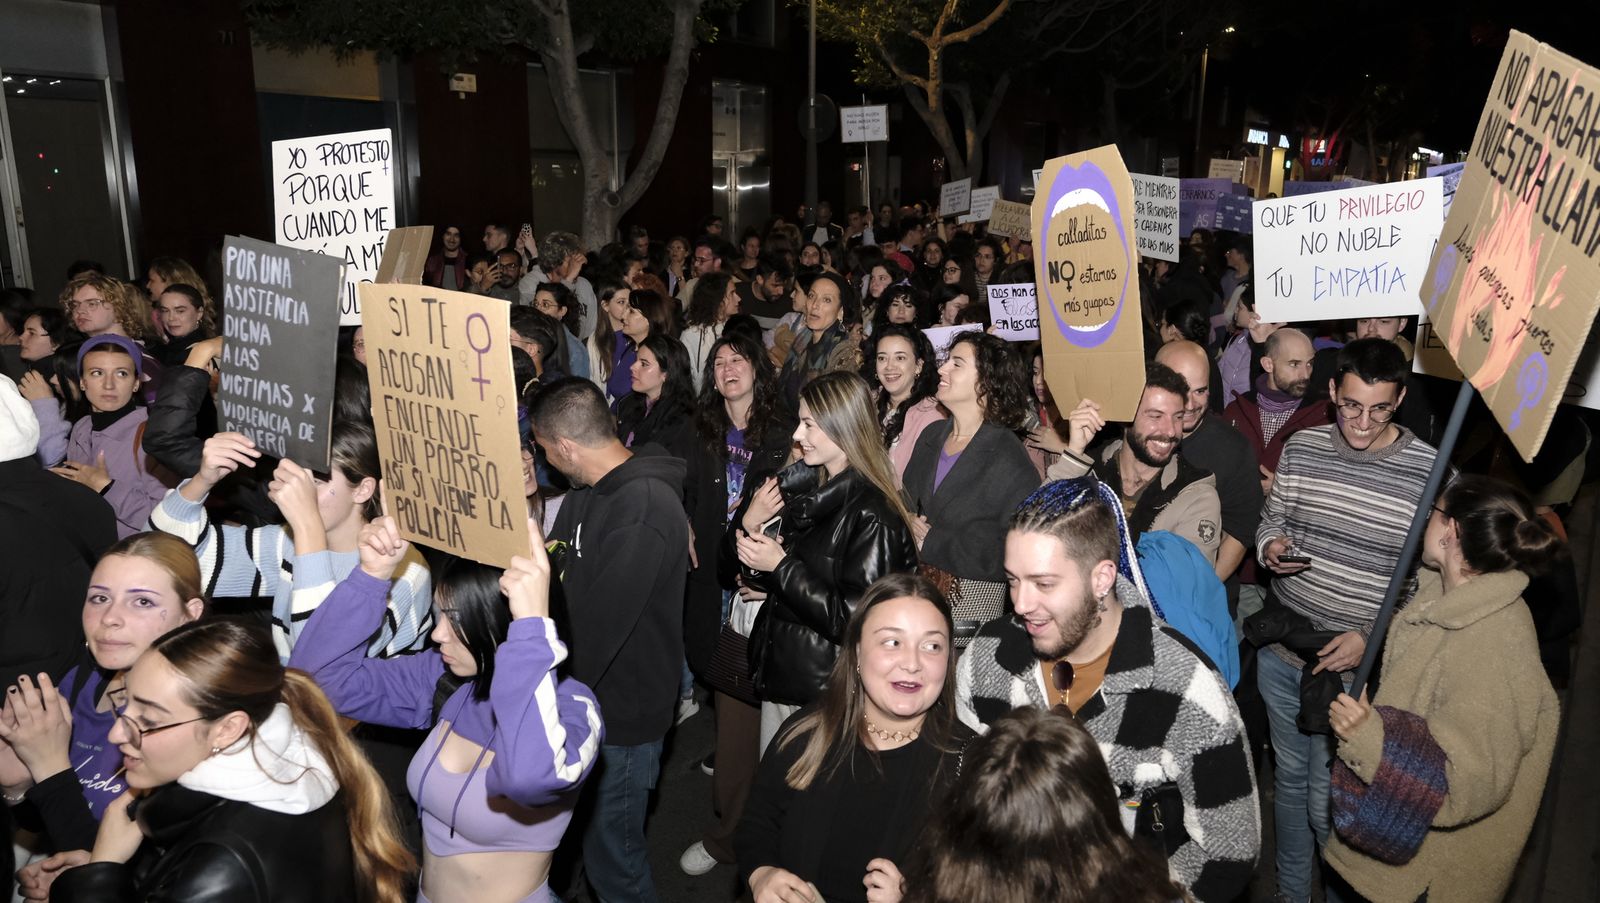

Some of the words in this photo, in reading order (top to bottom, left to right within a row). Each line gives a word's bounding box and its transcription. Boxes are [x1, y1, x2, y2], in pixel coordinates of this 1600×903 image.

[1496, 48, 1531, 110] NO
[1520, 66, 1600, 174] APAGAR
[288, 147, 306, 169] YO
[316, 140, 389, 170] PROTESTO
[1475, 108, 1552, 213] NUESTRA
[283, 172, 373, 205] PORQUE
[1145, 181, 1177, 200] MIENTRAS
[283, 208, 357, 242] CUANDO
[364, 206, 389, 233] ME
[1146, 201, 1178, 221] PRISIONERA
[1260, 204, 1298, 229] QUE
[1302, 200, 1327, 224] TU
[1338, 189, 1426, 222] PRIVILEGIO
[1057, 214, 1107, 247] calladitas
[1139, 236, 1147, 249] DE
[1147, 238, 1158, 251] LAS
[1140, 219, 1173, 236] CADENAS
[1300, 231, 1329, 256] NO
[1337, 224, 1402, 253] NUBLE
[226, 245, 257, 283] POR
[260, 253, 292, 289] UNA
[344, 244, 359, 271] A
[990, 287, 1009, 299] nos
[1011, 285, 1028, 298] han
[1048, 260, 1075, 292] NO
[1079, 263, 1117, 284] estamos
[1266, 266, 1294, 299] TU
[1313, 261, 1407, 302] EMPATIA
[222, 283, 310, 327] ASISTENCIA
[1063, 296, 1081, 313] más
[1083, 296, 1115, 317] guapas
[223, 314, 272, 347] DIGNA
[388, 296, 410, 337] SI
[421, 297, 451, 350] TE
[1010, 316, 1025, 332] las
[222, 343, 231, 364] A
[234, 346, 260, 372] LAS
[378, 347, 455, 401] ACOSAN
[220, 372, 294, 409] VICTIMAS
[221, 399, 292, 437] VIOLENCIA
[298, 421, 315, 442] DE
[384, 394, 486, 458] ENCIENDE
[389, 431, 417, 466] UN
[424, 439, 501, 500] PORRO
[412, 466, 427, 501] SI
[430, 475, 478, 520] VIENE
[487, 498, 514, 532] LA
